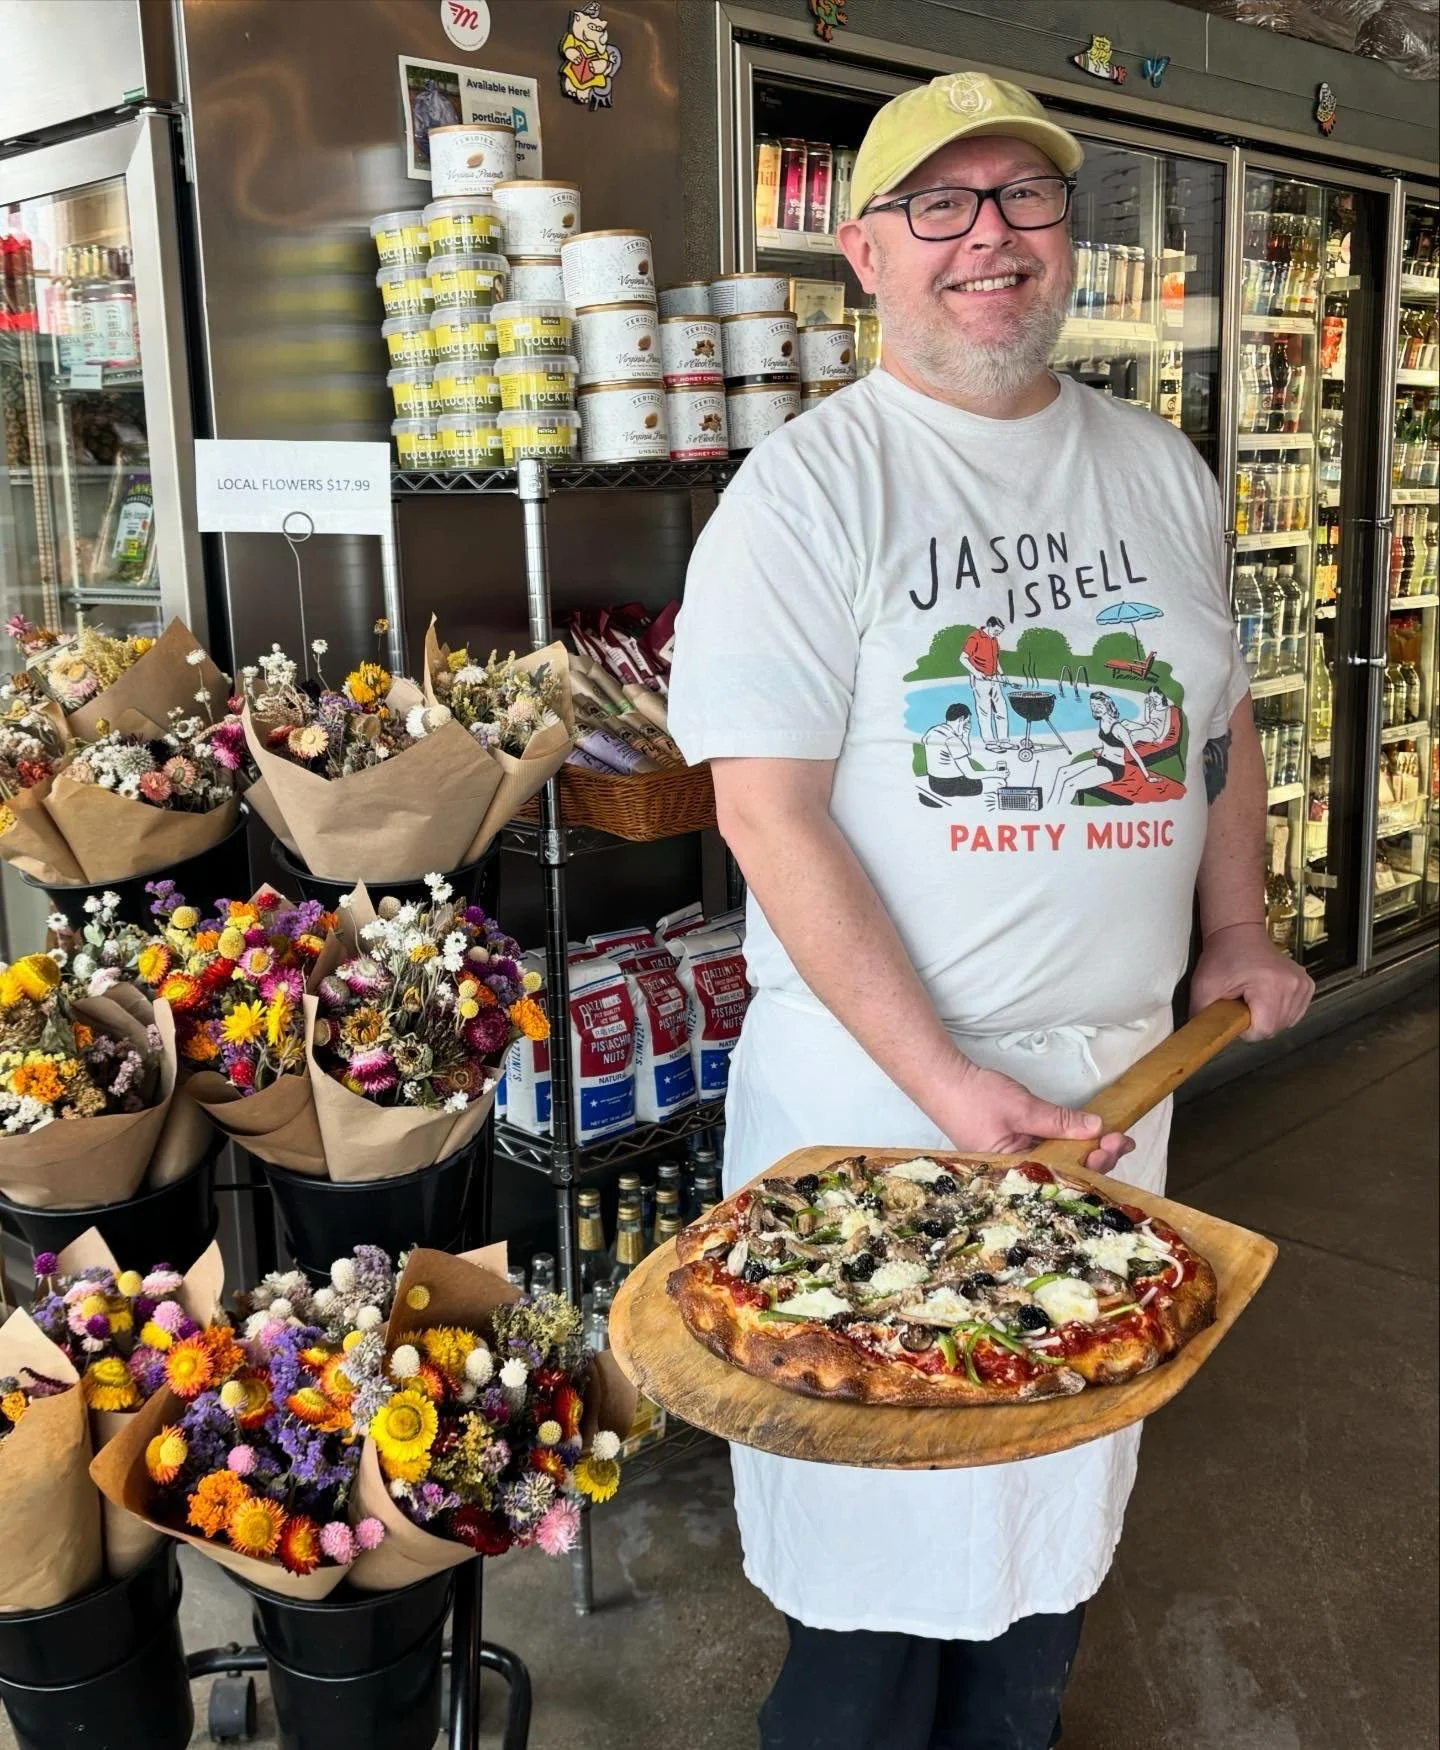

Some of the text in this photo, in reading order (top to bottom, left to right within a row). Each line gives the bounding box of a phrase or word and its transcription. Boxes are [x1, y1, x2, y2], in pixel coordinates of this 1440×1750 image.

[466, 78, 531, 98] Available Here!
[472, 111, 513, 126] portland
[438, 234, 490, 248] COCKTAIL
[523, 335, 572, 347] COCKTAIL
[440, 342, 488, 356] COCKTAIL
[616, 353, 646, 368] Virginia
[761, 358, 788, 371] Virginia
[402, 399, 443, 411] COCKTA
[444, 396, 495, 408] COCKTAIL
[405, 451, 446, 461] COCKTA
[446, 448, 494, 459] COCKTAIL
[520, 444, 571, 457] COCKTAIL
[217, 478, 371, 493] LOCAL FLOWERS $17.99
[909, 531, 1069, 611] JASON
[1007, 539, 1148, 625] ISBELL
[950, 819, 1175, 854] PARTY MUSIC
[702, 962, 741, 996] BAZZINI'S
[718, 1039, 738, 1048] NATU
[603, 1053, 626, 1067] NUTS
